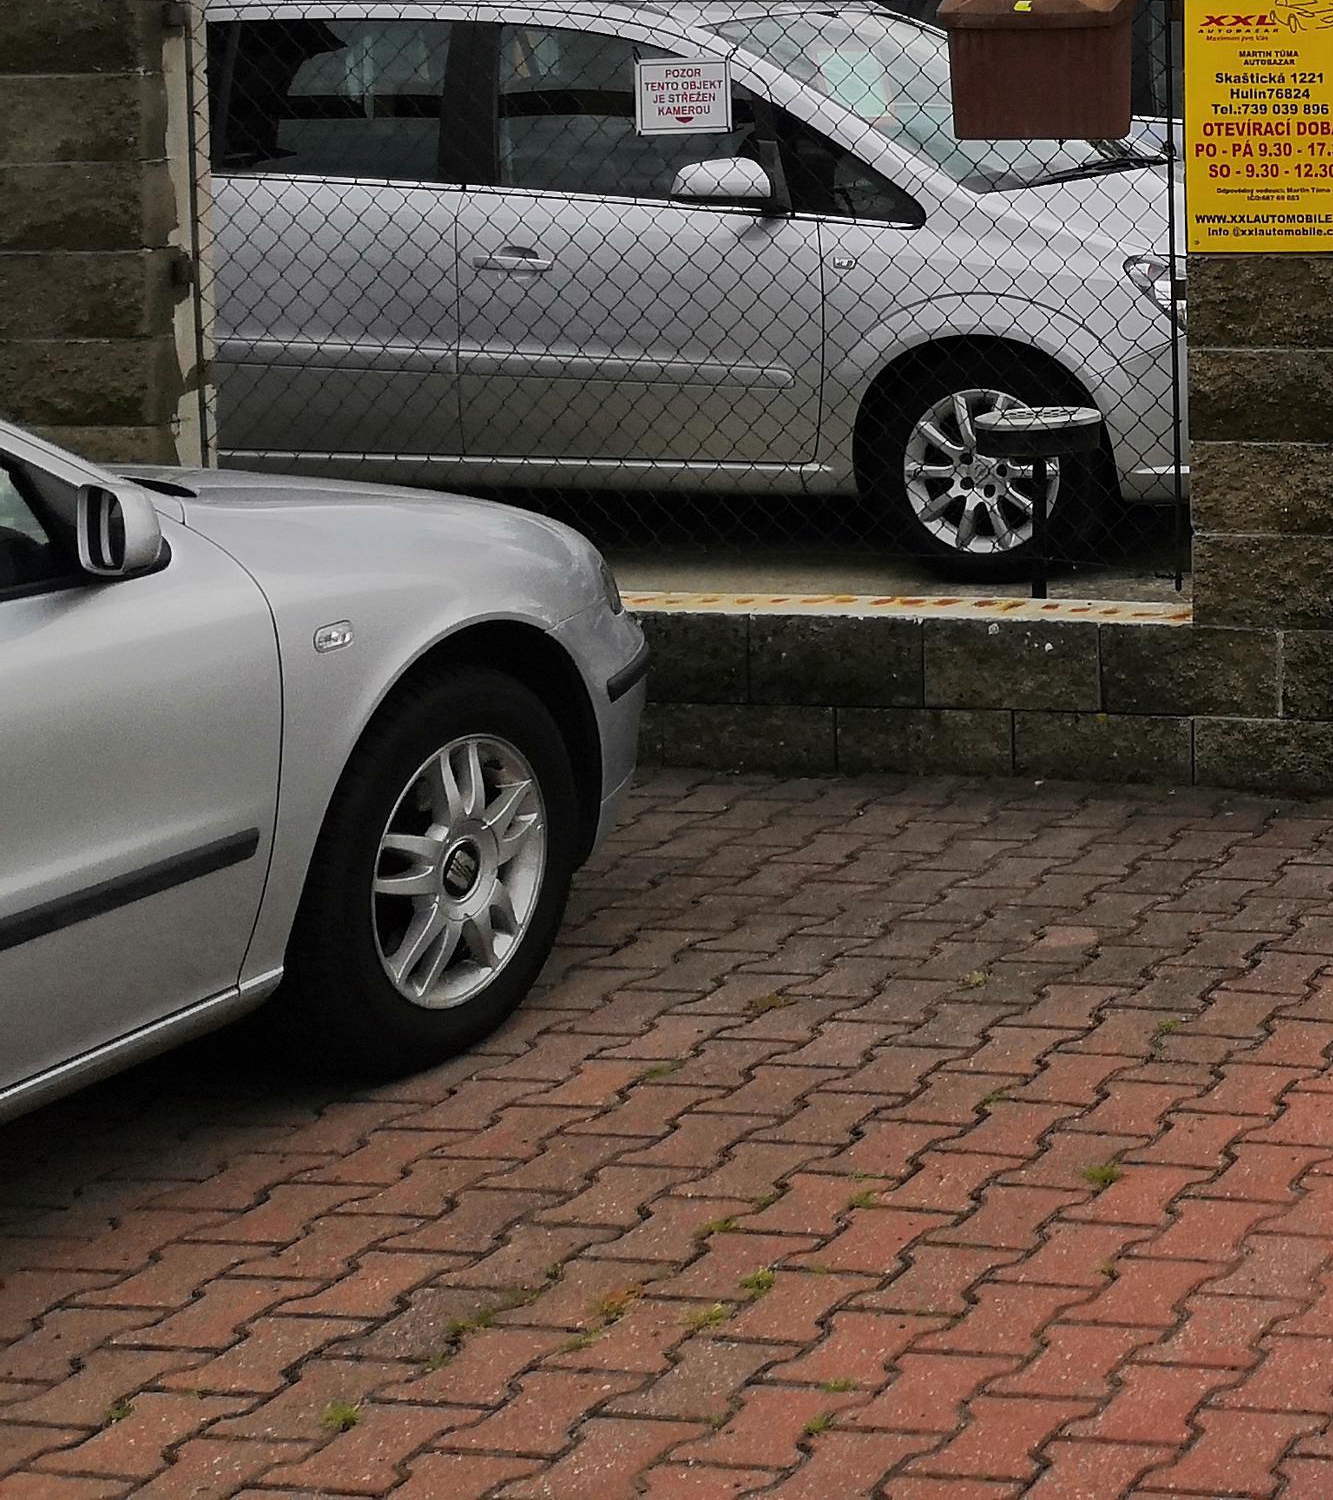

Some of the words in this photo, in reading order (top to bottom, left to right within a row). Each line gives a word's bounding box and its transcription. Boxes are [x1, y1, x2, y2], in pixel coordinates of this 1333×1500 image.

[1200, 15, 1277, 26] XXL
[665, 68, 701, 78] POZOR
[1215, 73, 1285, 84] Skaštická
[1290, 73, 1324, 84] 1221
[644, 82, 679, 91] TENTO
[681, 80, 723, 90] OBJEKT
[653, 95, 665, 104] JE
[668, 91, 716, 103] STŘEŽEN
[658, 105, 711, 116] KAMEROU
[1211, 103, 1266, 115] Tel.:739
[1272, 104, 1298, 115] 039
[1303, 104, 1329, 115] 896
[1203, 118, 1291, 136] OTEVÍRACÍ
[1195, 143, 1217, 157] PO
[1232, 139, 1253, 157] PÁ
[1259, 142, 1292, 156] 9.30
[1208, 164, 1231, 178] SO
[1246, 164, 1279, 178] 9.30
